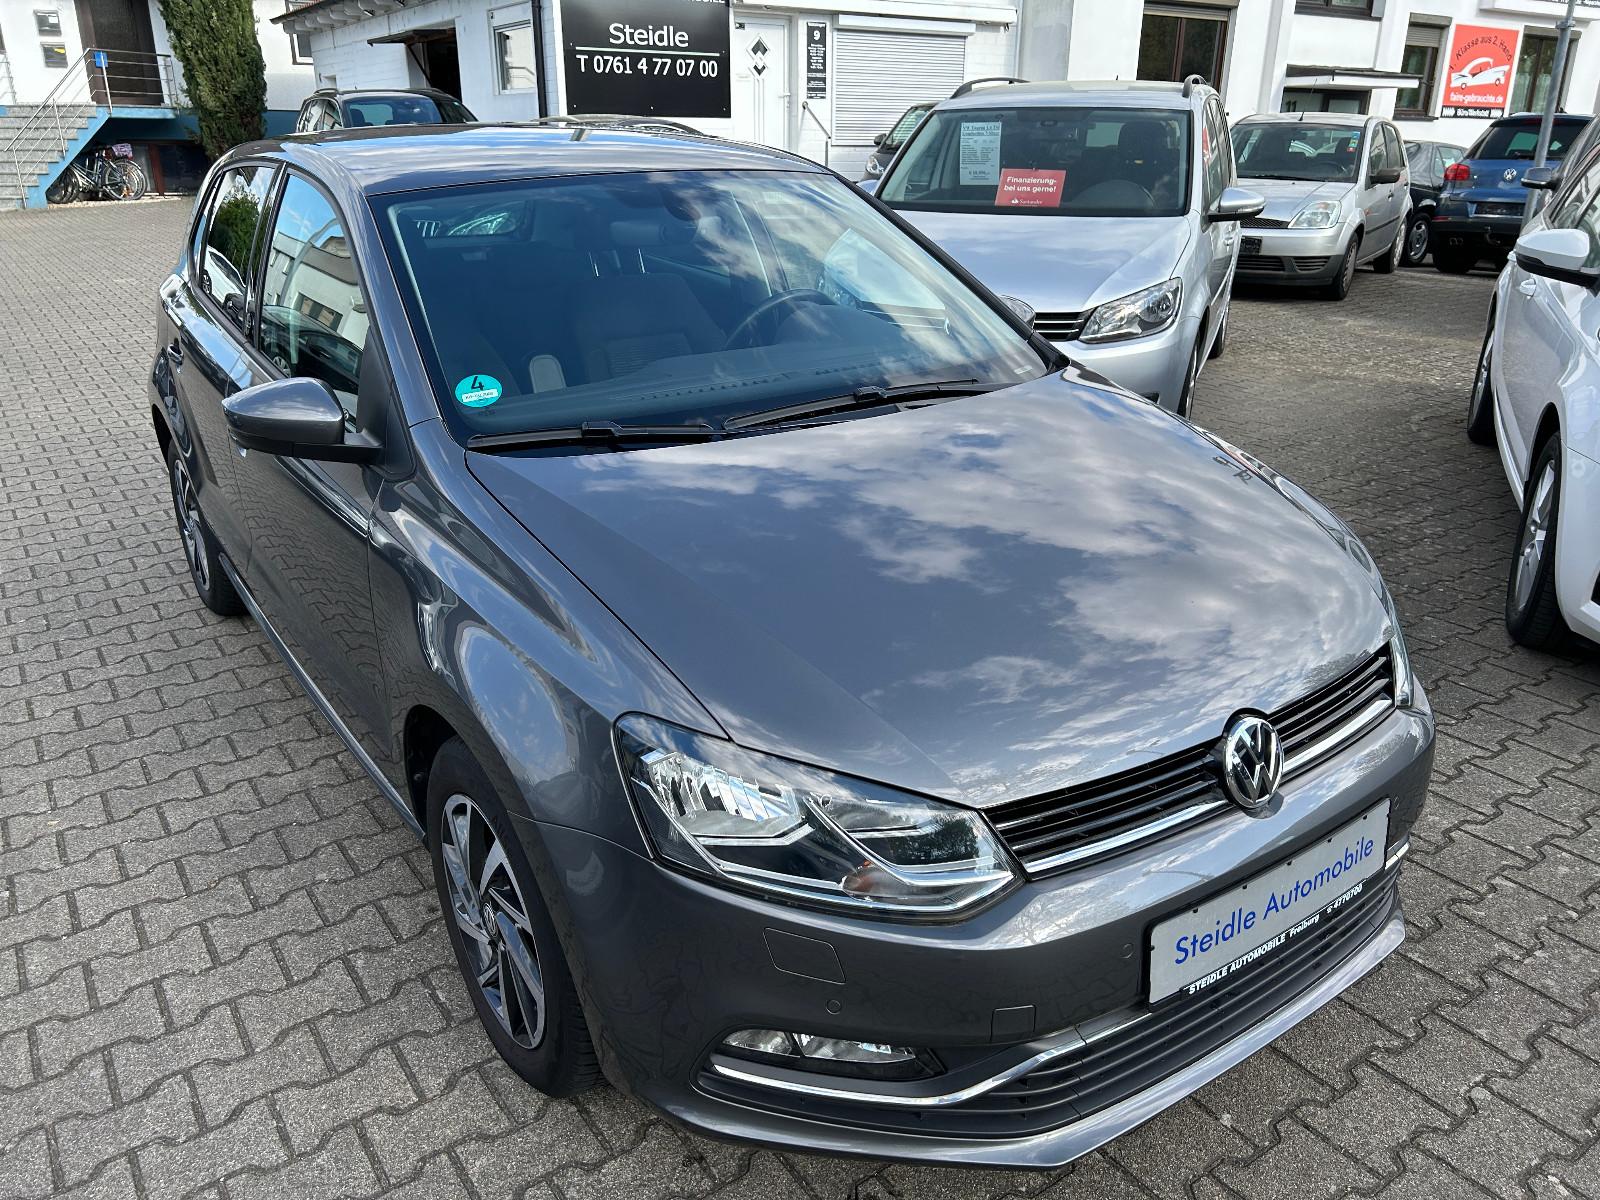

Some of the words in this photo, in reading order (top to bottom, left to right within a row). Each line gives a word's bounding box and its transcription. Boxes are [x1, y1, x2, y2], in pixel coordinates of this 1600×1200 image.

[608, 22, 689, 47] Steidle
[813, 30, 821, 41] 9
[1456, 38, 1480, 60] Klasse
[1480, 36, 1492, 44] aus
[1498, 40, 1512, 61] Hand
[576, 55, 589, 73] T
[593, 55, 632, 74] 0761
[637, 58, 648, 75] 4
[652, 58, 671, 76] 77
[676, 59, 695, 77] 07
[699, 60, 718, 78] 00
[1032, 186, 1057, 194] gerne!
[471, 375, 484, 390] 4
[1174, 907, 1256, 965] Steidle
[1262, 836, 1374, 920] Automobile
[1188, 966, 1228, 995] STEIDLE
[1229, 932, 1286, 973] AUTOMOBILE
[1289, 914, 1320, 938] Freiburg
[1333, 883, 1363, 909] 4770700
